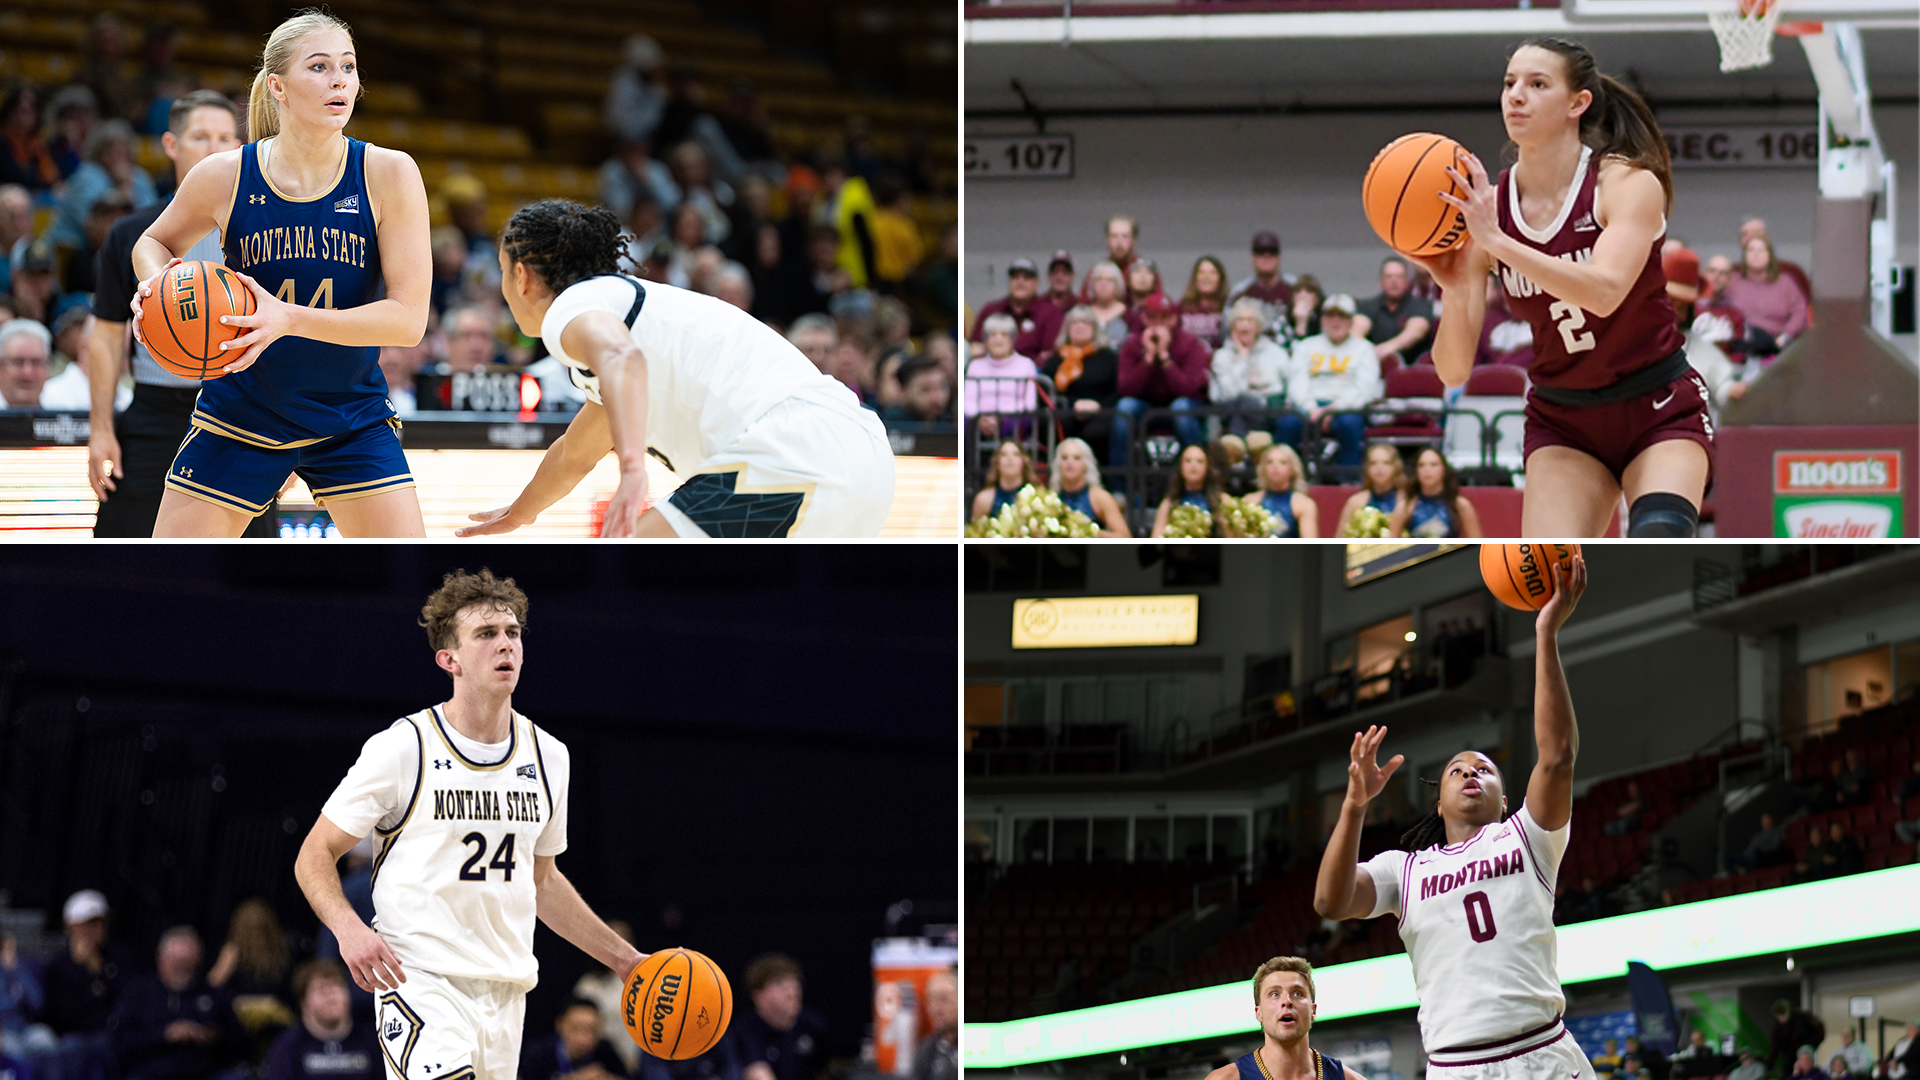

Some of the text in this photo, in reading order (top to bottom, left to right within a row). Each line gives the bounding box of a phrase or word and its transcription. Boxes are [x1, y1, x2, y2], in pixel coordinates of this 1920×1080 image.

[1005, 143, 1065, 170] 107
[1664, 133, 1817, 161] SEC. 106
[240, 226, 366, 269] MONTANA STATE
[177, 266, 199, 322] ELITE
[1549, 300, 1596, 354] 2
[1789, 455, 1887, 486] noon's
[1519, 544, 1546, 598] Wilso
[433, 789, 540, 823] MONTANA STATE
[458, 831, 516, 882] 24
[1420, 848, 1525, 901] MONTANA
[1463, 890, 1497, 943] 0
[626, 974, 645, 1028] NCAA
[650, 974, 683, 1045] Wilson
